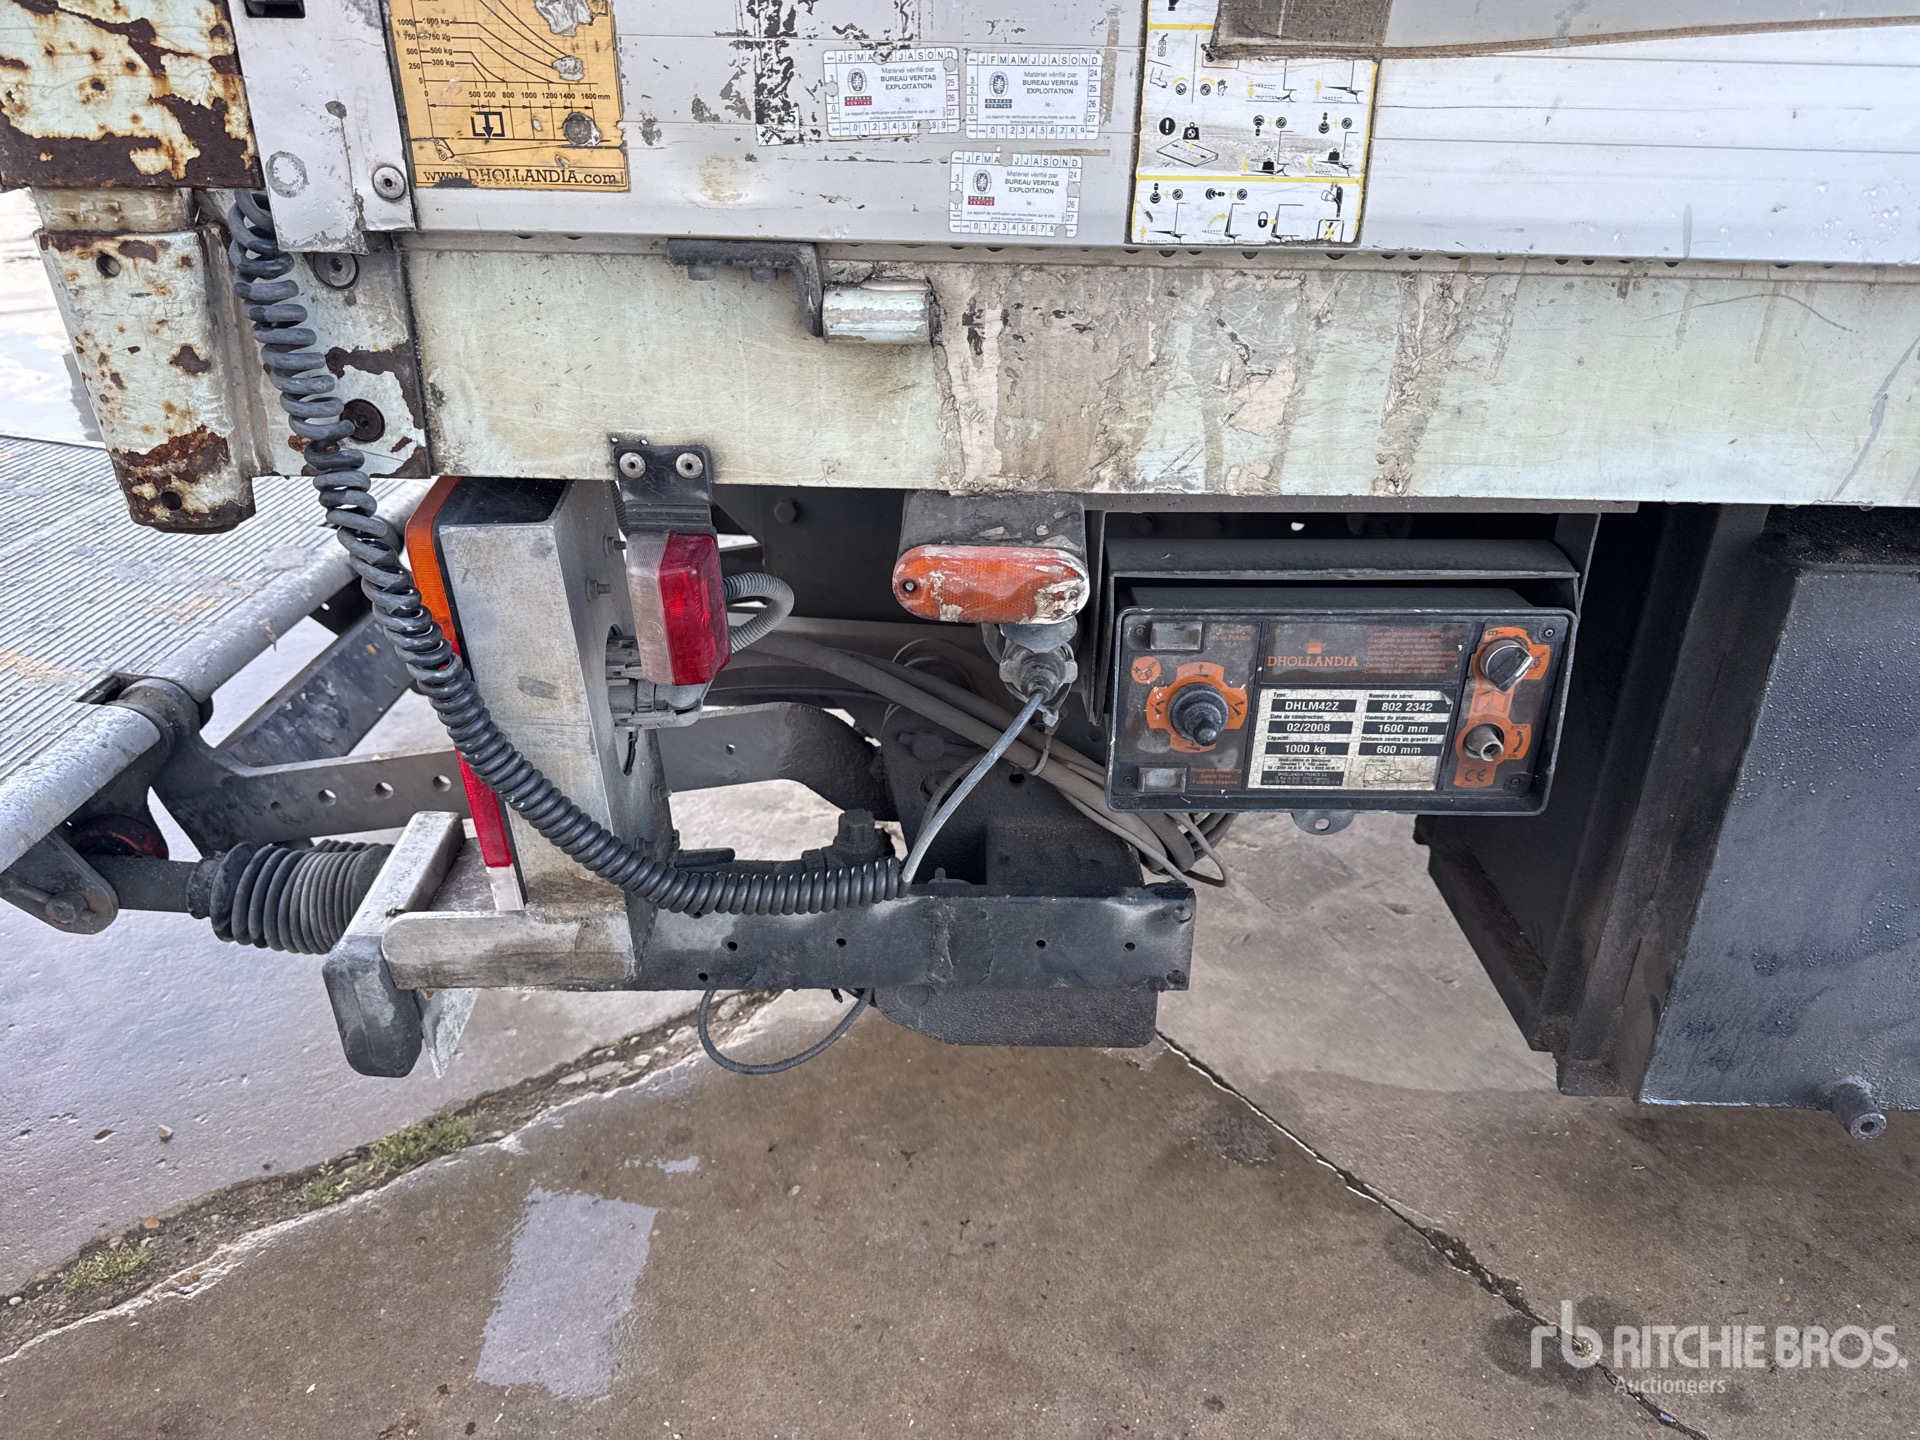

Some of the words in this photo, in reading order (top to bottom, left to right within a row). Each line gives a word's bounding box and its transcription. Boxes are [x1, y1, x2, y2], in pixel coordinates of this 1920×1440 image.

[440, 18, 450, 26] kg
[444, 48, 453, 56] kg
[423, 168, 616, 184] wwwDHOLLANDIA.com
[1267, 656, 1358, 666] DHOLLANDIA
[1285, 701, 1340, 711] DHLM42Z
[1381, 702, 1402, 711] 802
[1405, 702, 1433, 711] 2342
[1286, 723, 1330, 732] 02/2008
[1378, 724, 1404, 733] 1600
[1284, 744, 1310, 753] 1000
[1314, 744, 1326, 755] kg
[1376, 745, 1396, 754] 600
